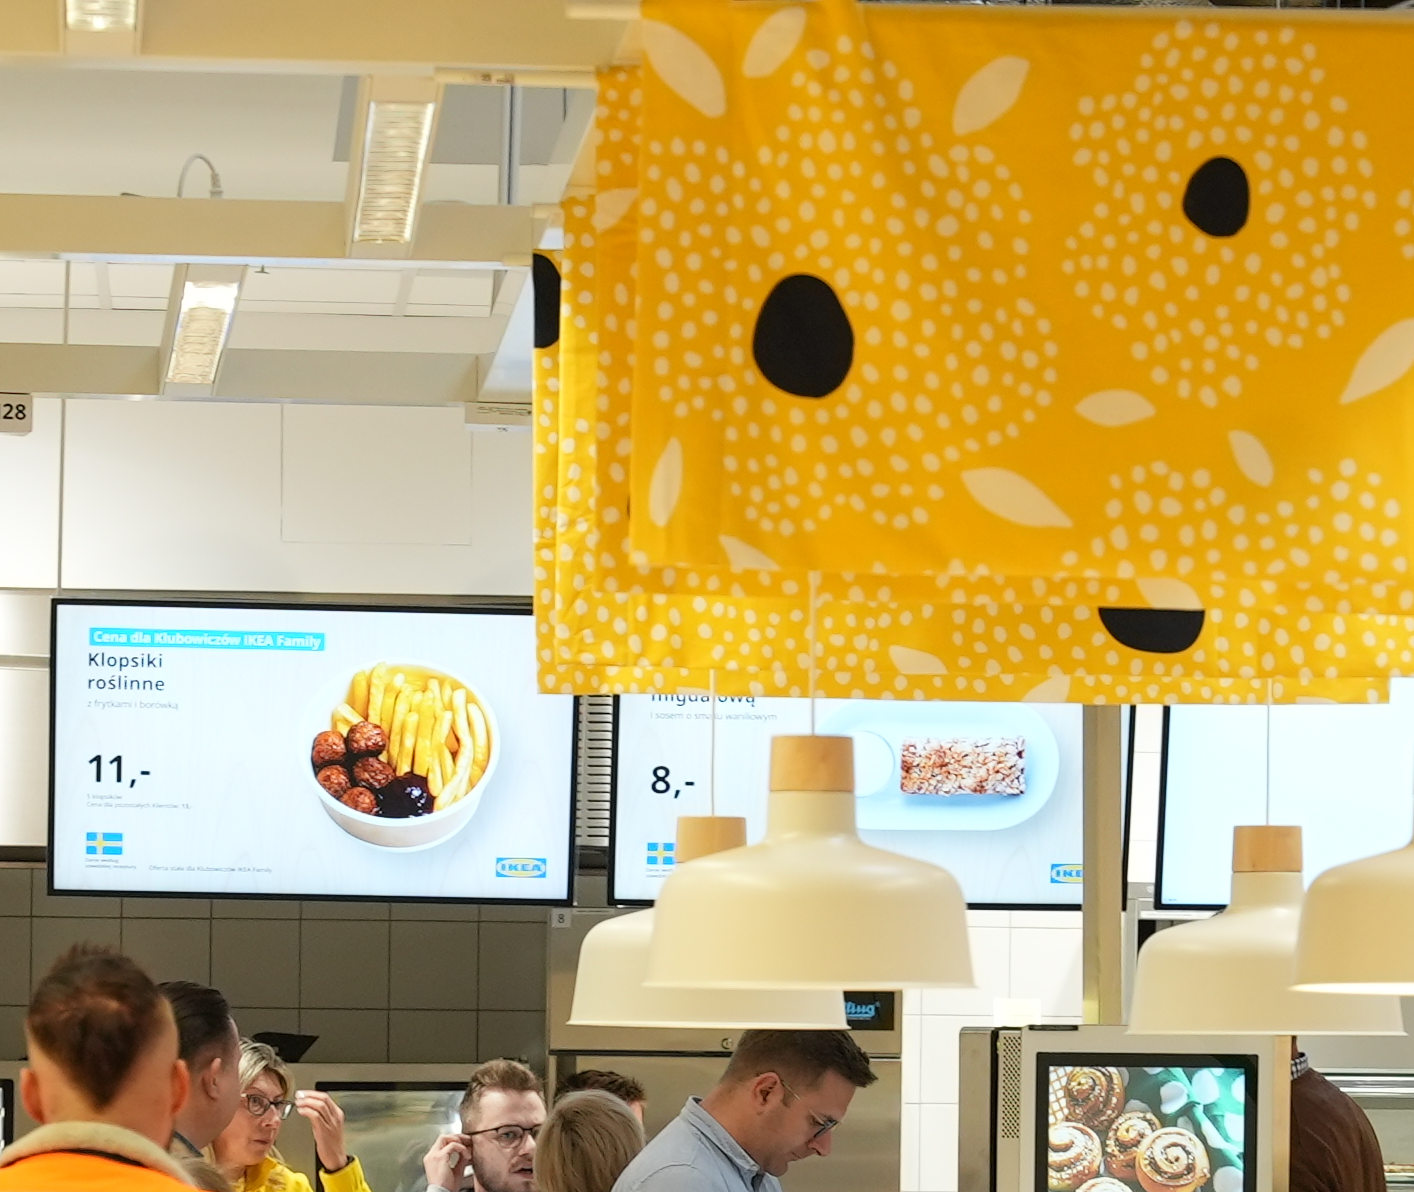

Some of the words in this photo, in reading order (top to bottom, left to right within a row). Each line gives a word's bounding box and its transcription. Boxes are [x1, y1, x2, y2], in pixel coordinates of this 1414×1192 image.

[93, 630, 127, 644] Cena
[130, 631, 152, 644] dla
[154, 632, 241, 646] Klubowiczów
[244, 634, 274, 646] IKEA
[277, 635, 322, 651] Family
[88, 652, 164, 671] Klopsiki
[88, 674, 165, 691] roślinne
[88, 754, 151, 788] 11,-
[651, 765, 695, 799] 8,-
[501, 863, 542, 872] IKEA
[1055, 869, 1083, 878] IKE
[557, 913, 565, 924] 8
